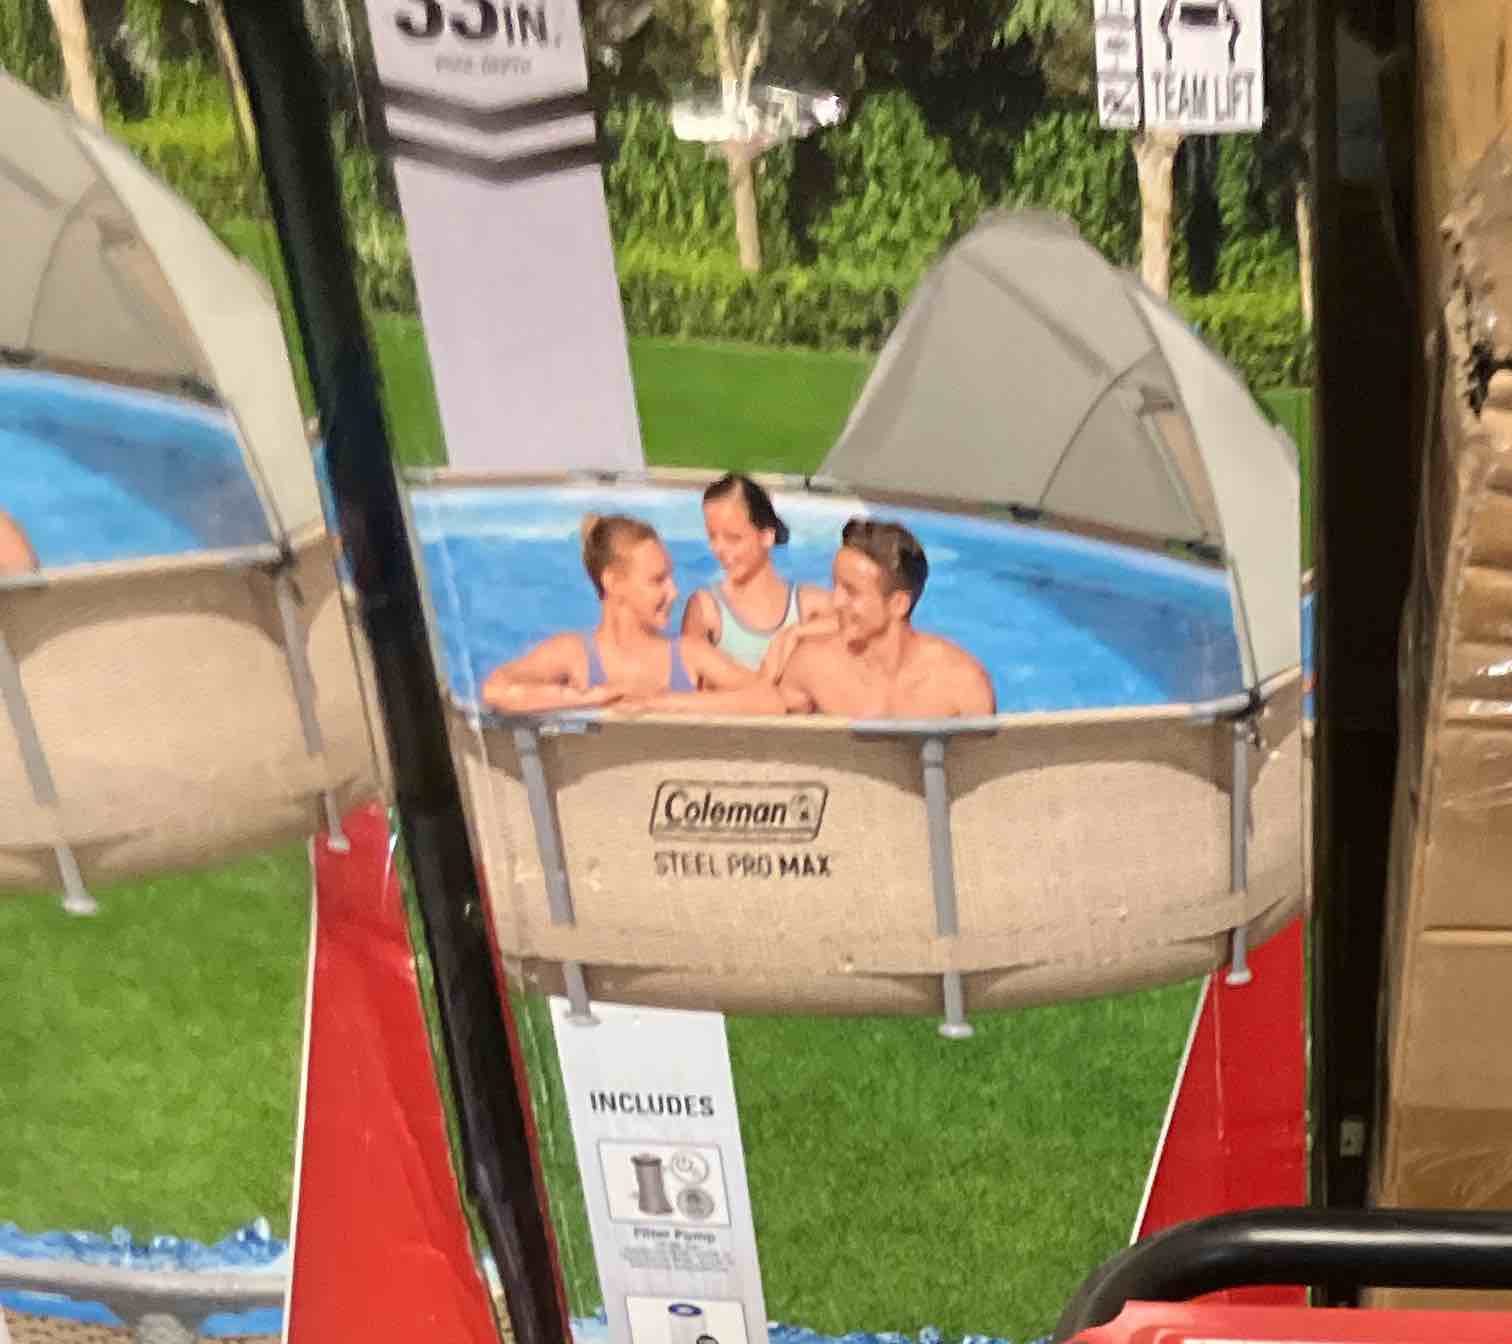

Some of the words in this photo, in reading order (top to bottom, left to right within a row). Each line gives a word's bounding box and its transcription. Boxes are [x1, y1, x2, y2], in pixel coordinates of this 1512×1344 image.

[1152, 70, 1208, 119] TEAM
[1215, 68, 1257, 120] LIFT
[665, 790, 787, 824] Coleman
[654, 850, 720, 879] STEEL
[727, 851, 772, 878] PRO
[779, 852, 832, 880] MAX
[590, 1091, 714, 1117] INCLUDES
